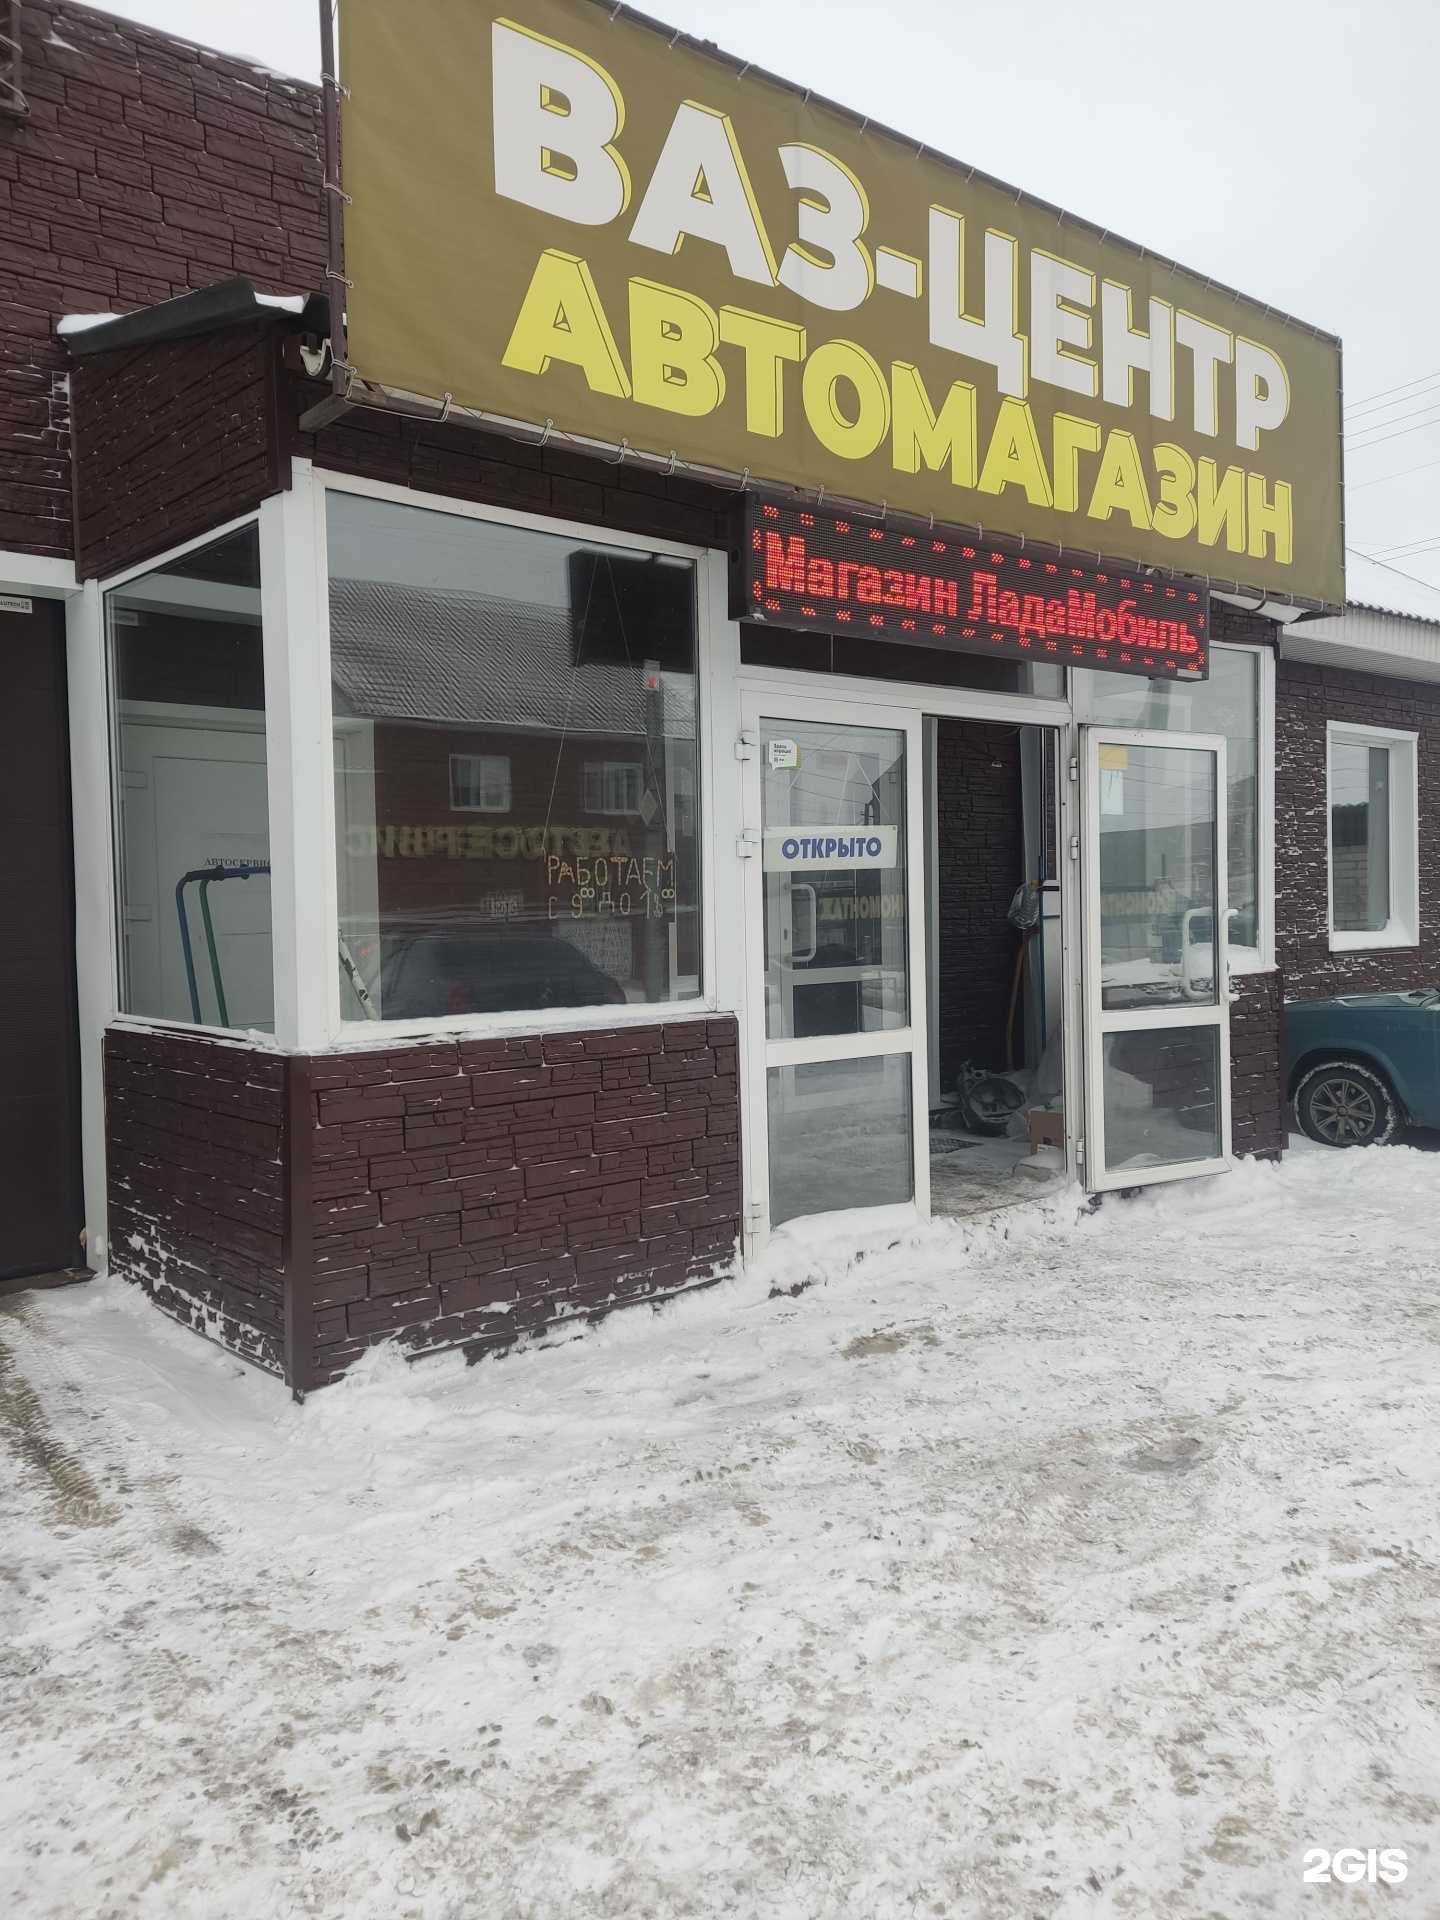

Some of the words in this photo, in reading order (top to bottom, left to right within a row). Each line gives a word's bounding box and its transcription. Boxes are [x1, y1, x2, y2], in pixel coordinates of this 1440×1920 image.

[490, 17, 1291, 452] ВАЗ-ЦЕНТР
[500, 247, 1293, 566] АВТОМАГАЗИН
[765, 530, 958, 618] Магазин
[967, 571, 1199, 654] ЛадаМобиль
[547, 855, 675, 888] РАБОТАЕМ
[781, 836, 882, 859] ОТКРЫТО
